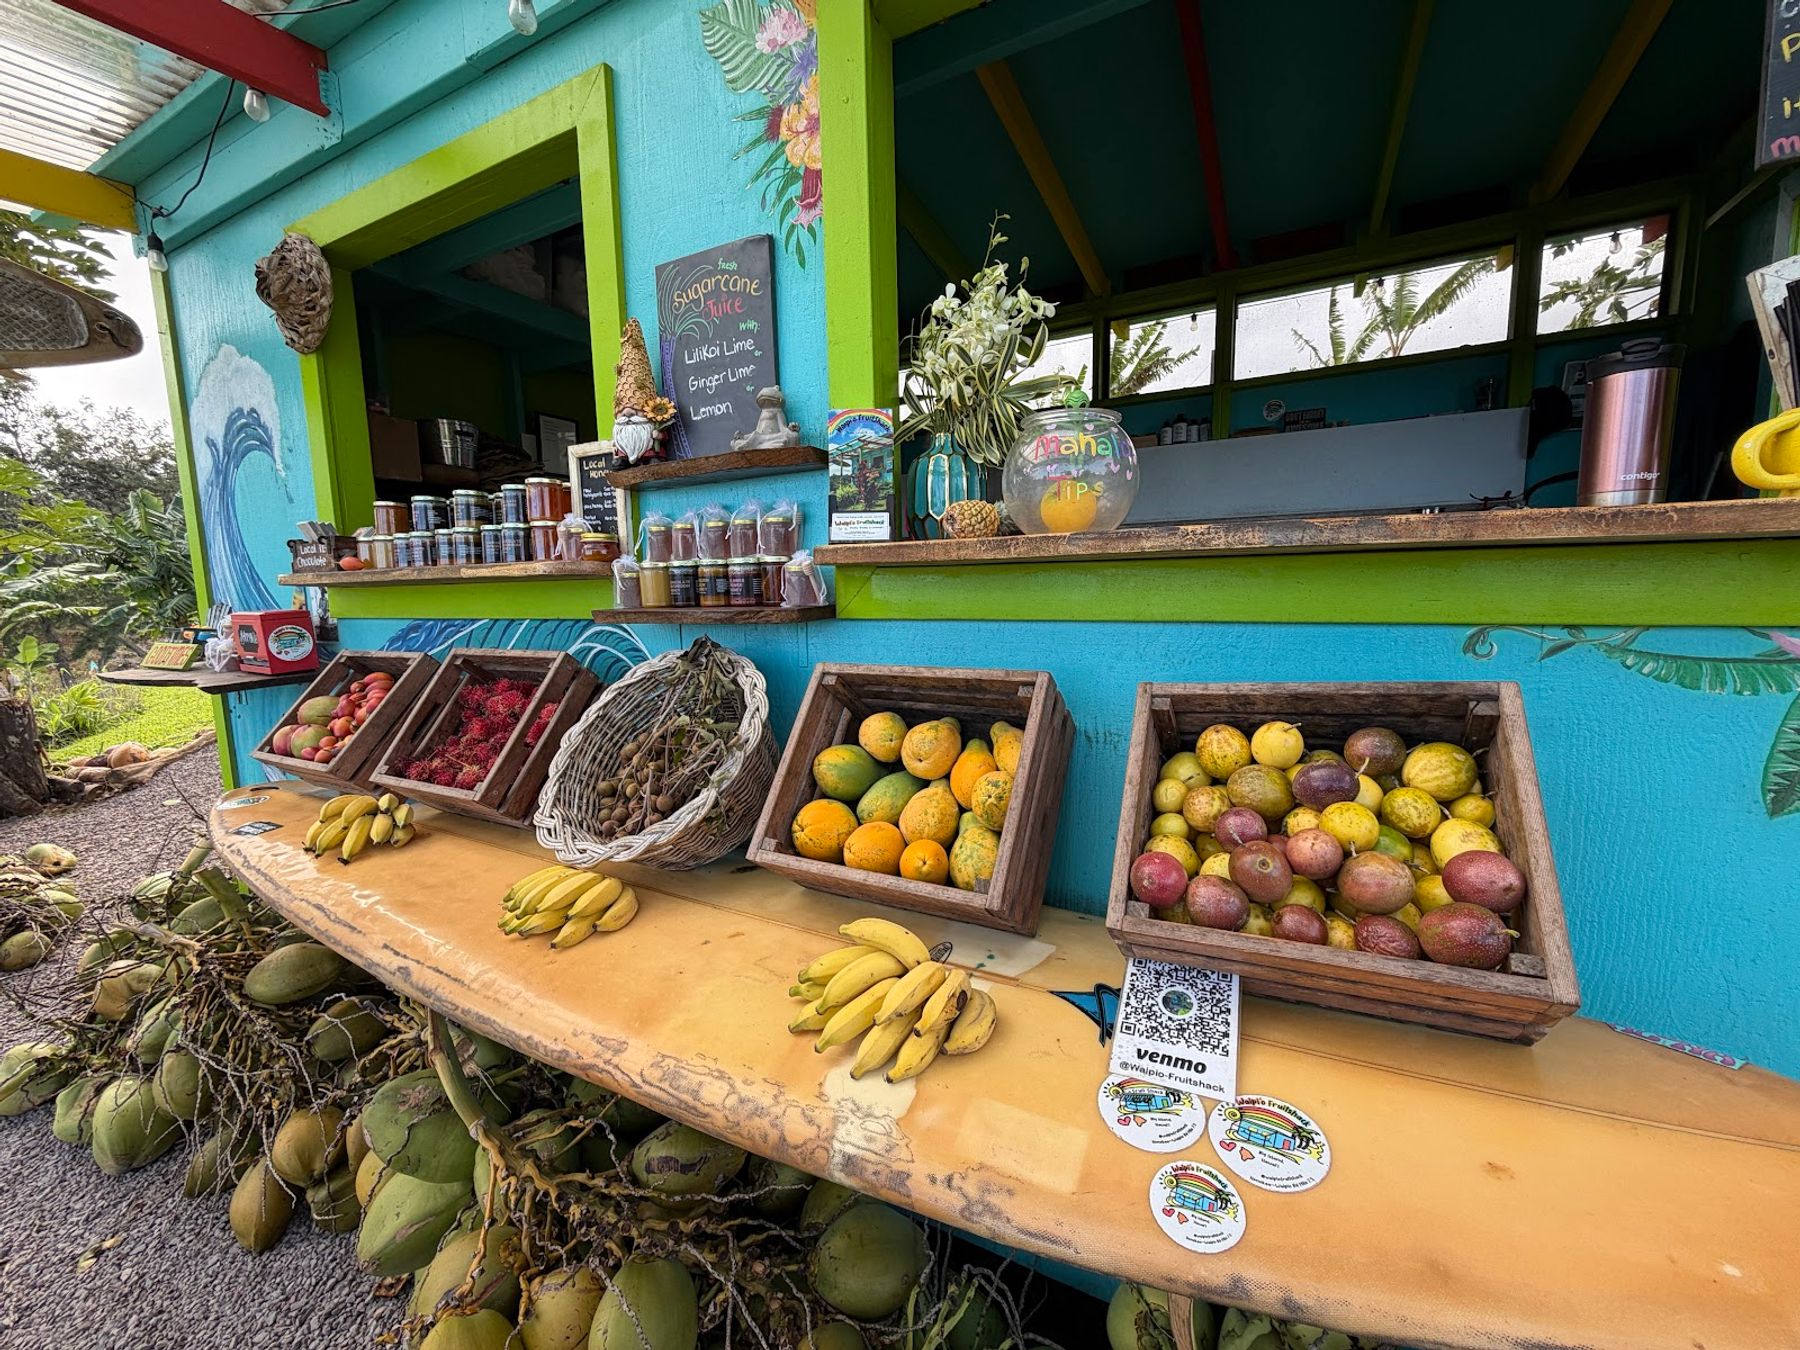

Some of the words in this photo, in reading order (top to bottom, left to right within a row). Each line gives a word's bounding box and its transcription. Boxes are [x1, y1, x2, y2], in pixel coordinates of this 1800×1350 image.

[717, 257, 738, 270] fresh
[672, 274, 763, 314] Sugarcane
[703, 297, 745, 322] Juice
[723, 337, 756, 357] Lime
[688, 372, 727, 394] Ginger
[727, 364, 757, 383] Lime
[689, 401, 733, 421] Lemon
[583, 457, 606, 470] Local
[1620, 471, 1658, 481] contigo
[1047, 474, 1104, 502] Tips
[300, 544, 317, 555] Local
[296, 556, 327, 568] Chocolate
[1136, 1048, 1207, 1074] venmo
[1119, 1061, 1225, 1093] @Waipio-Fruitshack
